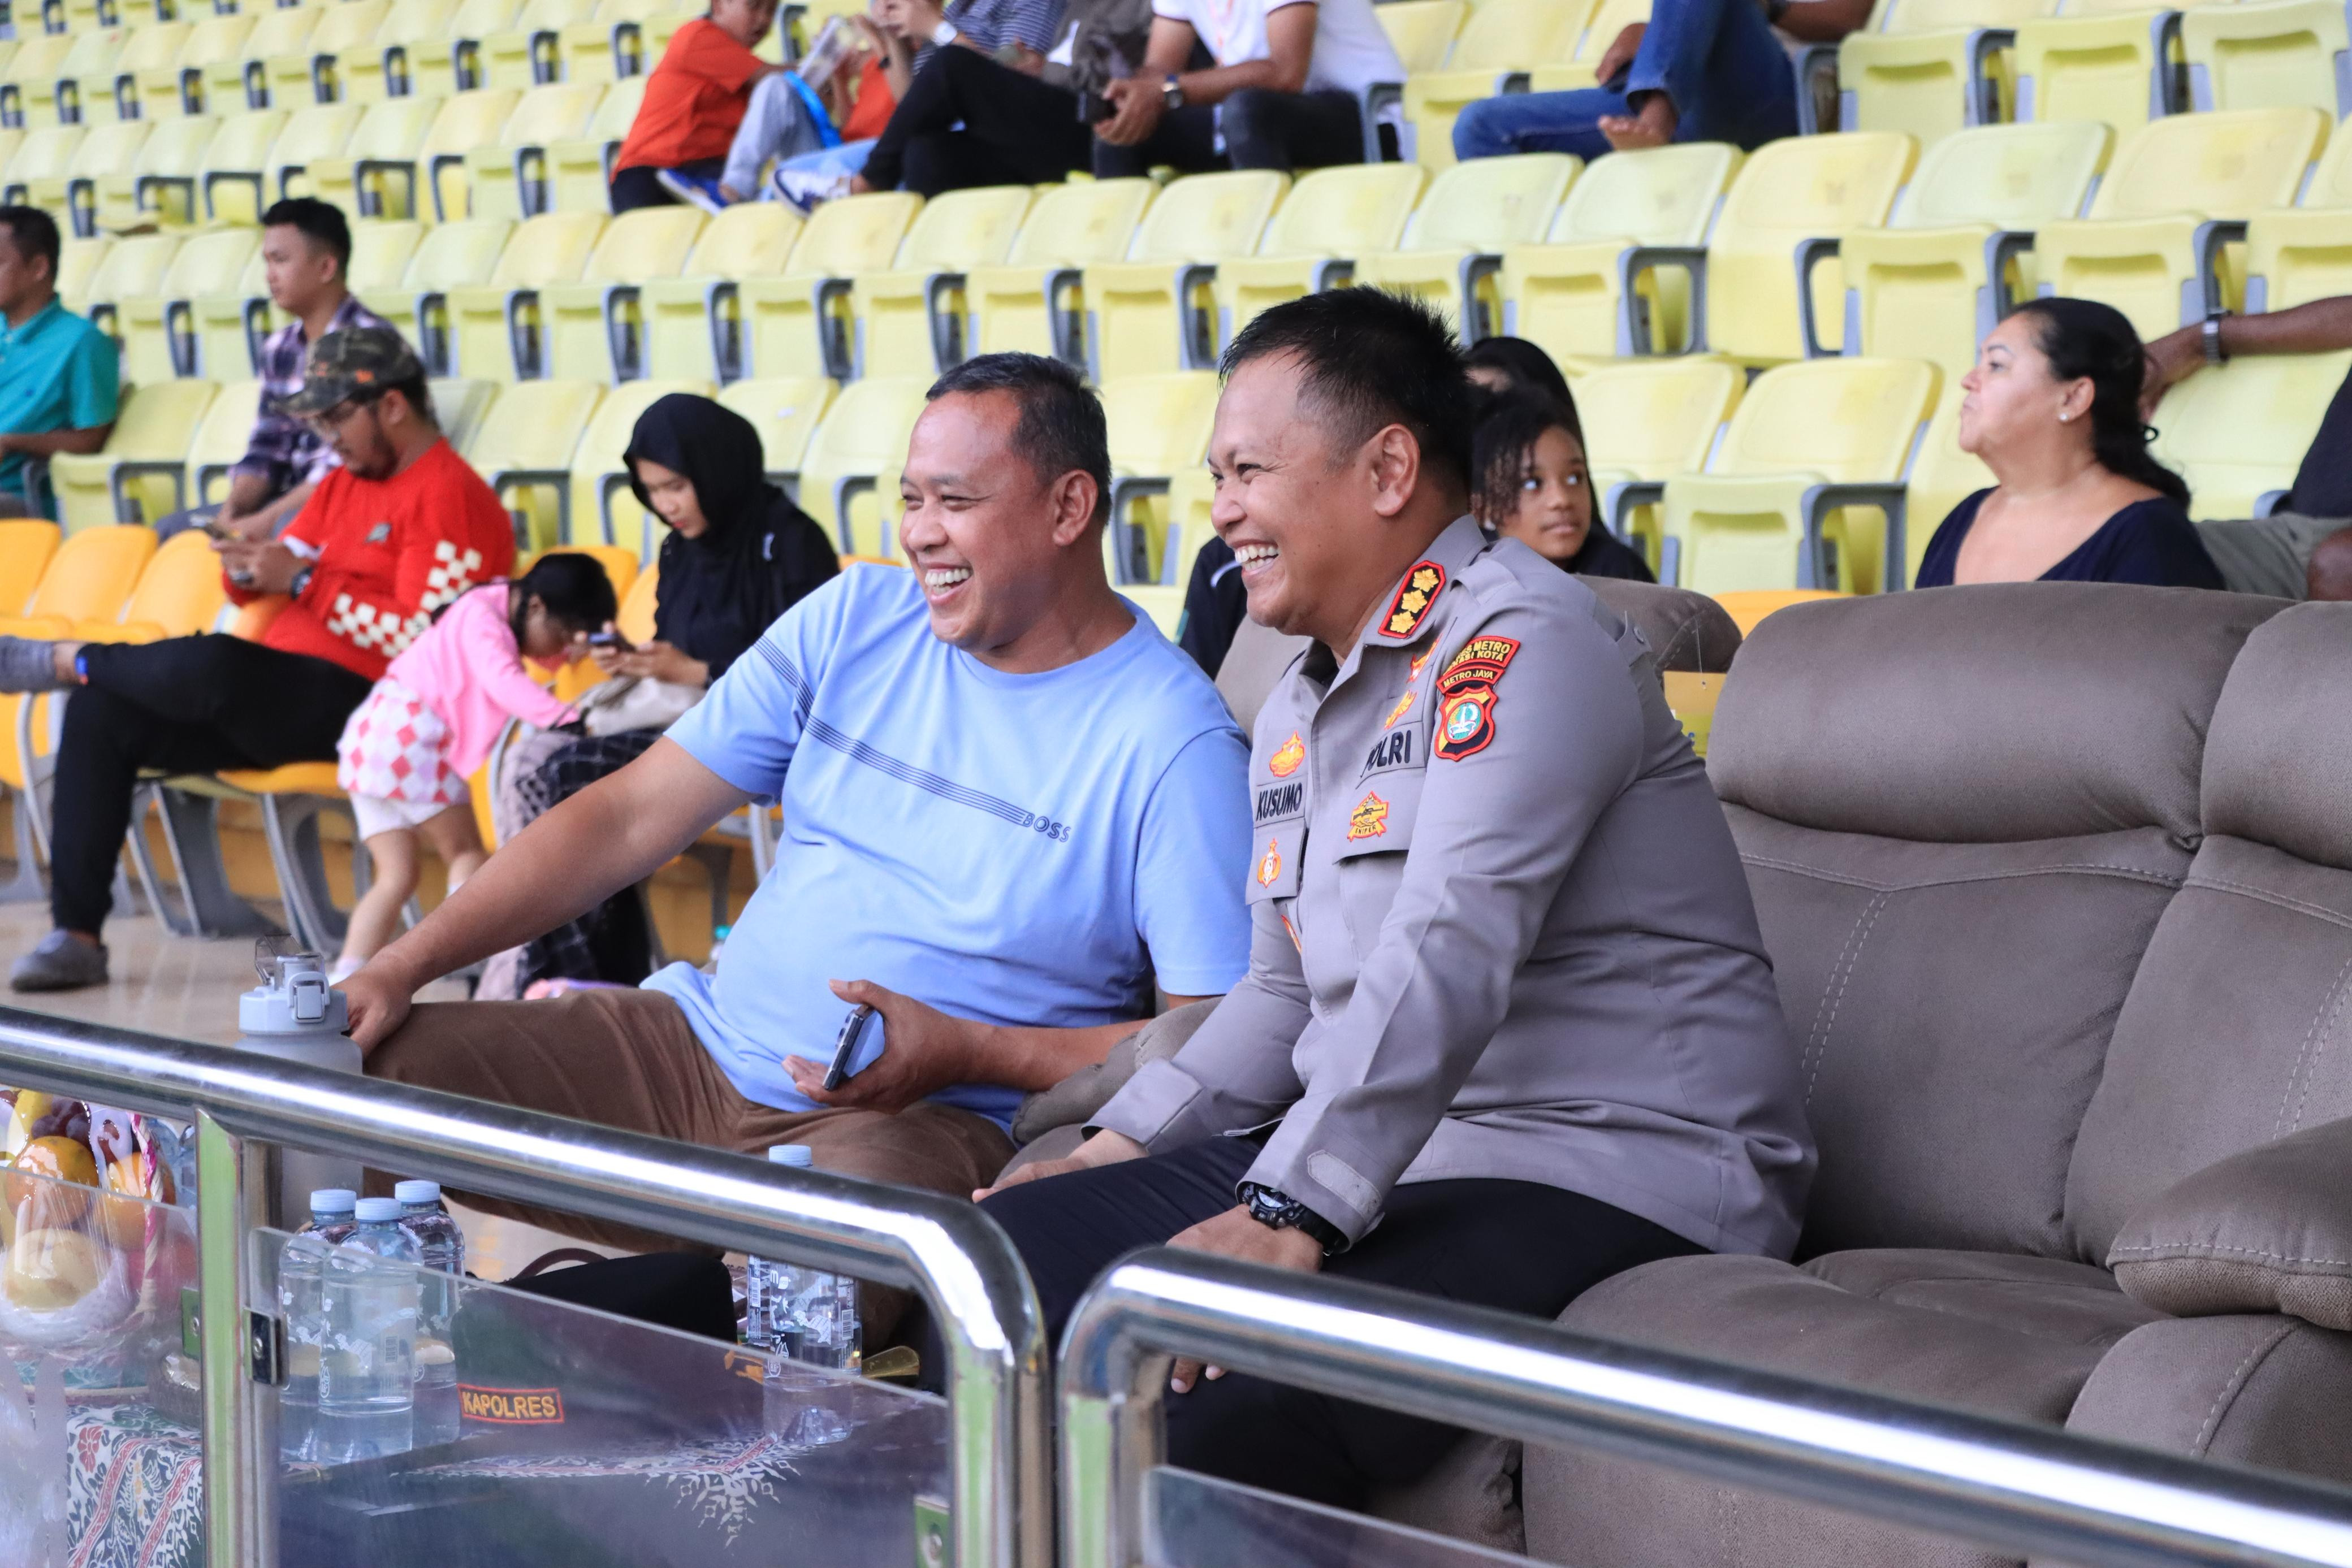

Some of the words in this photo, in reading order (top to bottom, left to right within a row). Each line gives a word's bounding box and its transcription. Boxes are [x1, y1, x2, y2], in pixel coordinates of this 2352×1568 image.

[1473, 640, 1511, 654] METRO
[1477, 651, 1504, 662] KOTA
[1443, 671, 1472, 688] METRO
[1473, 669, 1493, 680] JAYA
[1256, 782, 1303, 821] KUSUMO
[1023, 813, 1071, 843] BOSS
[1355, 825, 1376, 835] SNIPER
[462, 1392, 556, 1419] KAPOLRES
